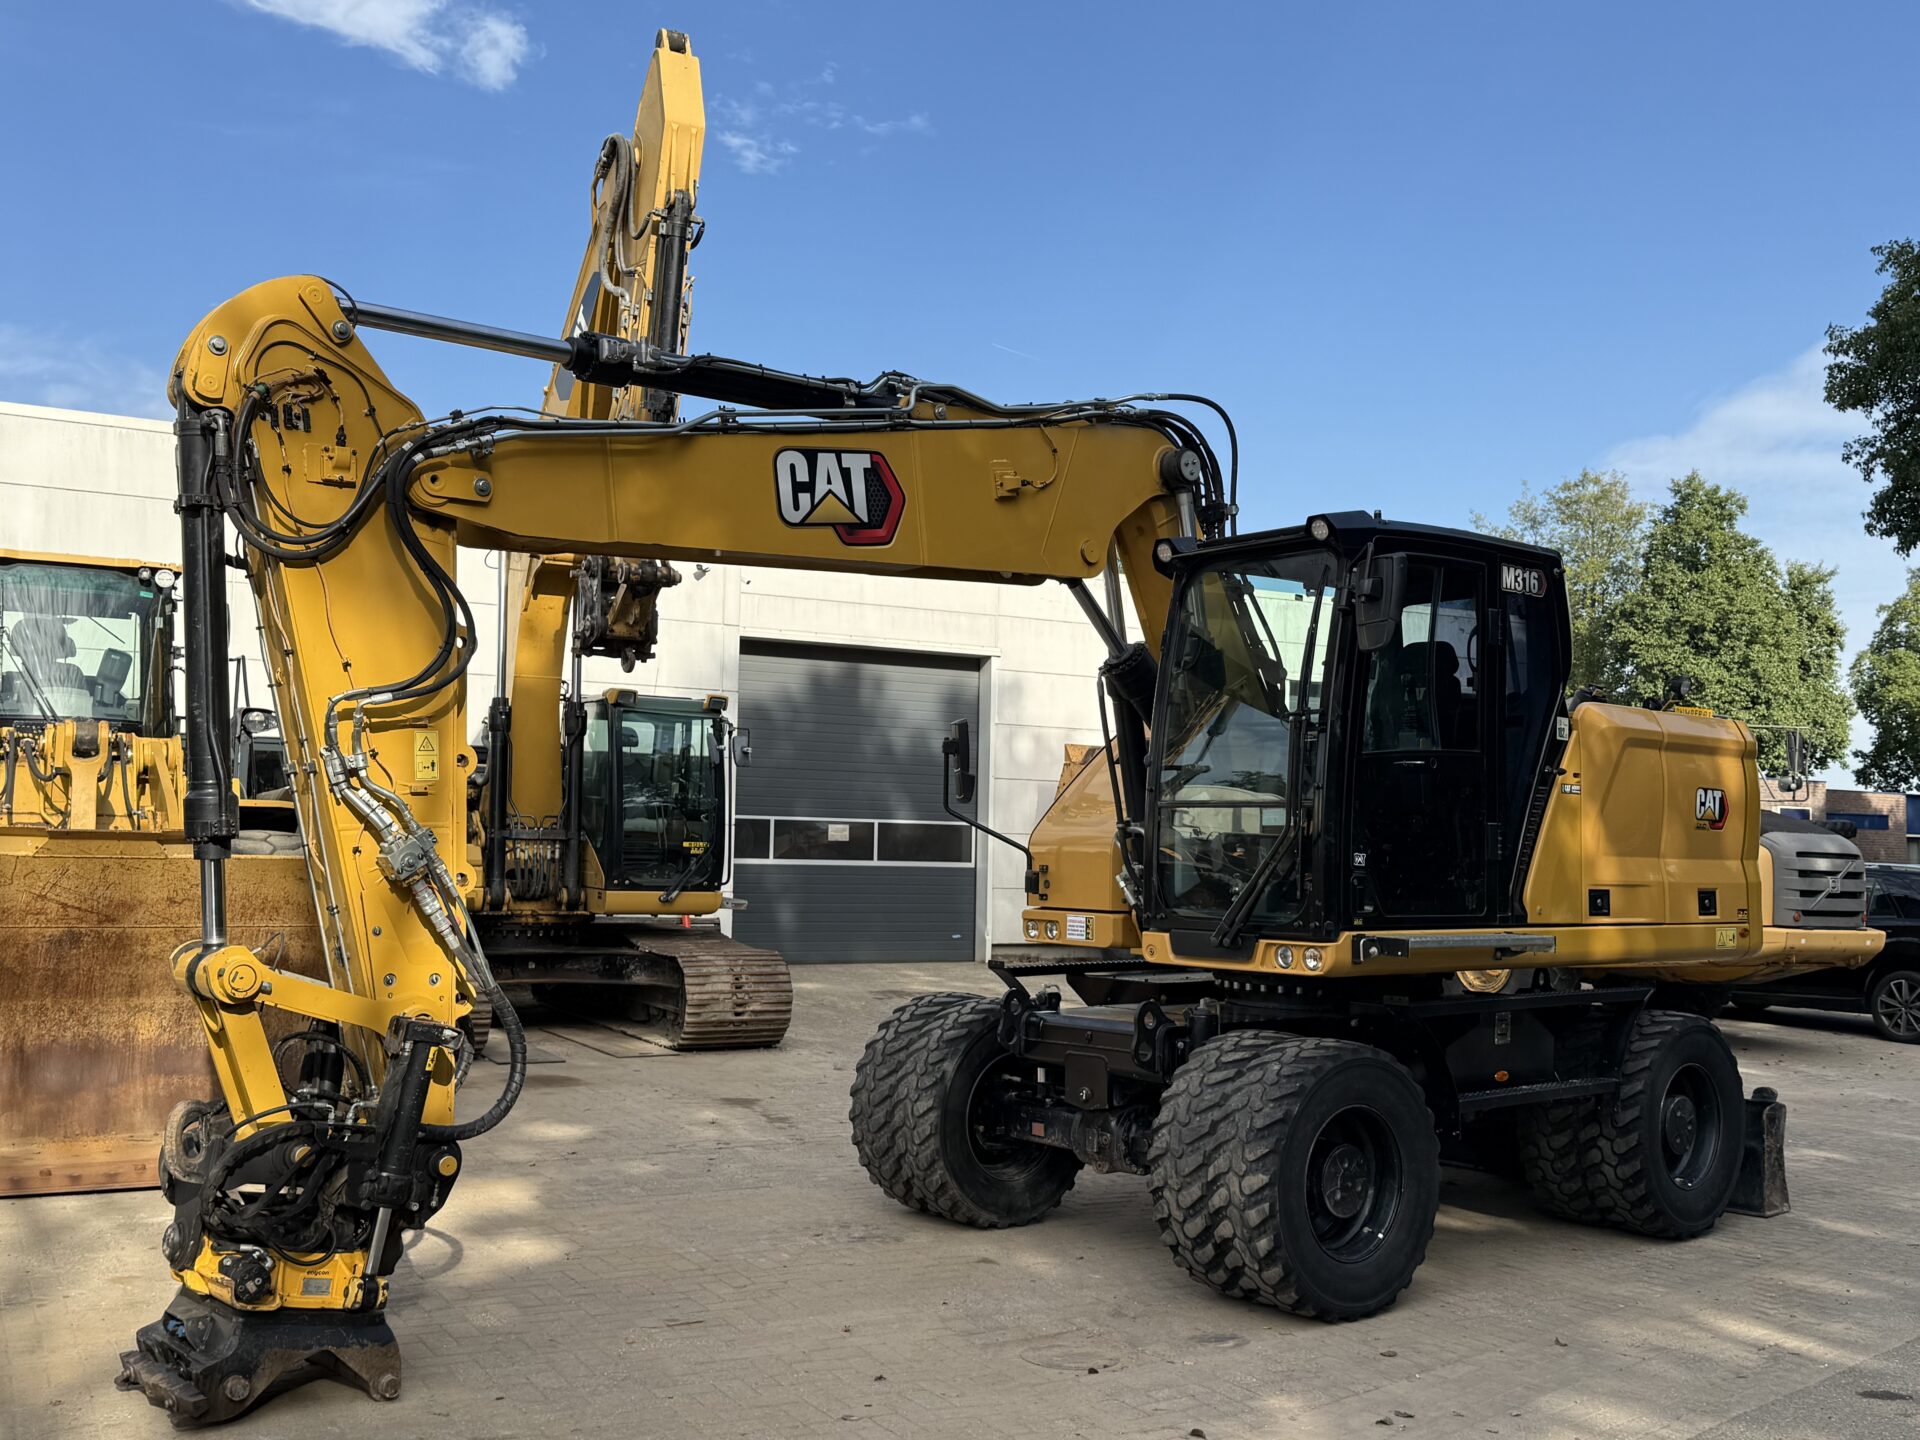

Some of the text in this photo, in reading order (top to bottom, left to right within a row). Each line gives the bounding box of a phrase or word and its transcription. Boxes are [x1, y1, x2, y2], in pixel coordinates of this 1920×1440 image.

[776, 450, 872, 524] CAT
[1502, 565, 1539, 594] M316
[1696, 788, 1722, 821] CAT
